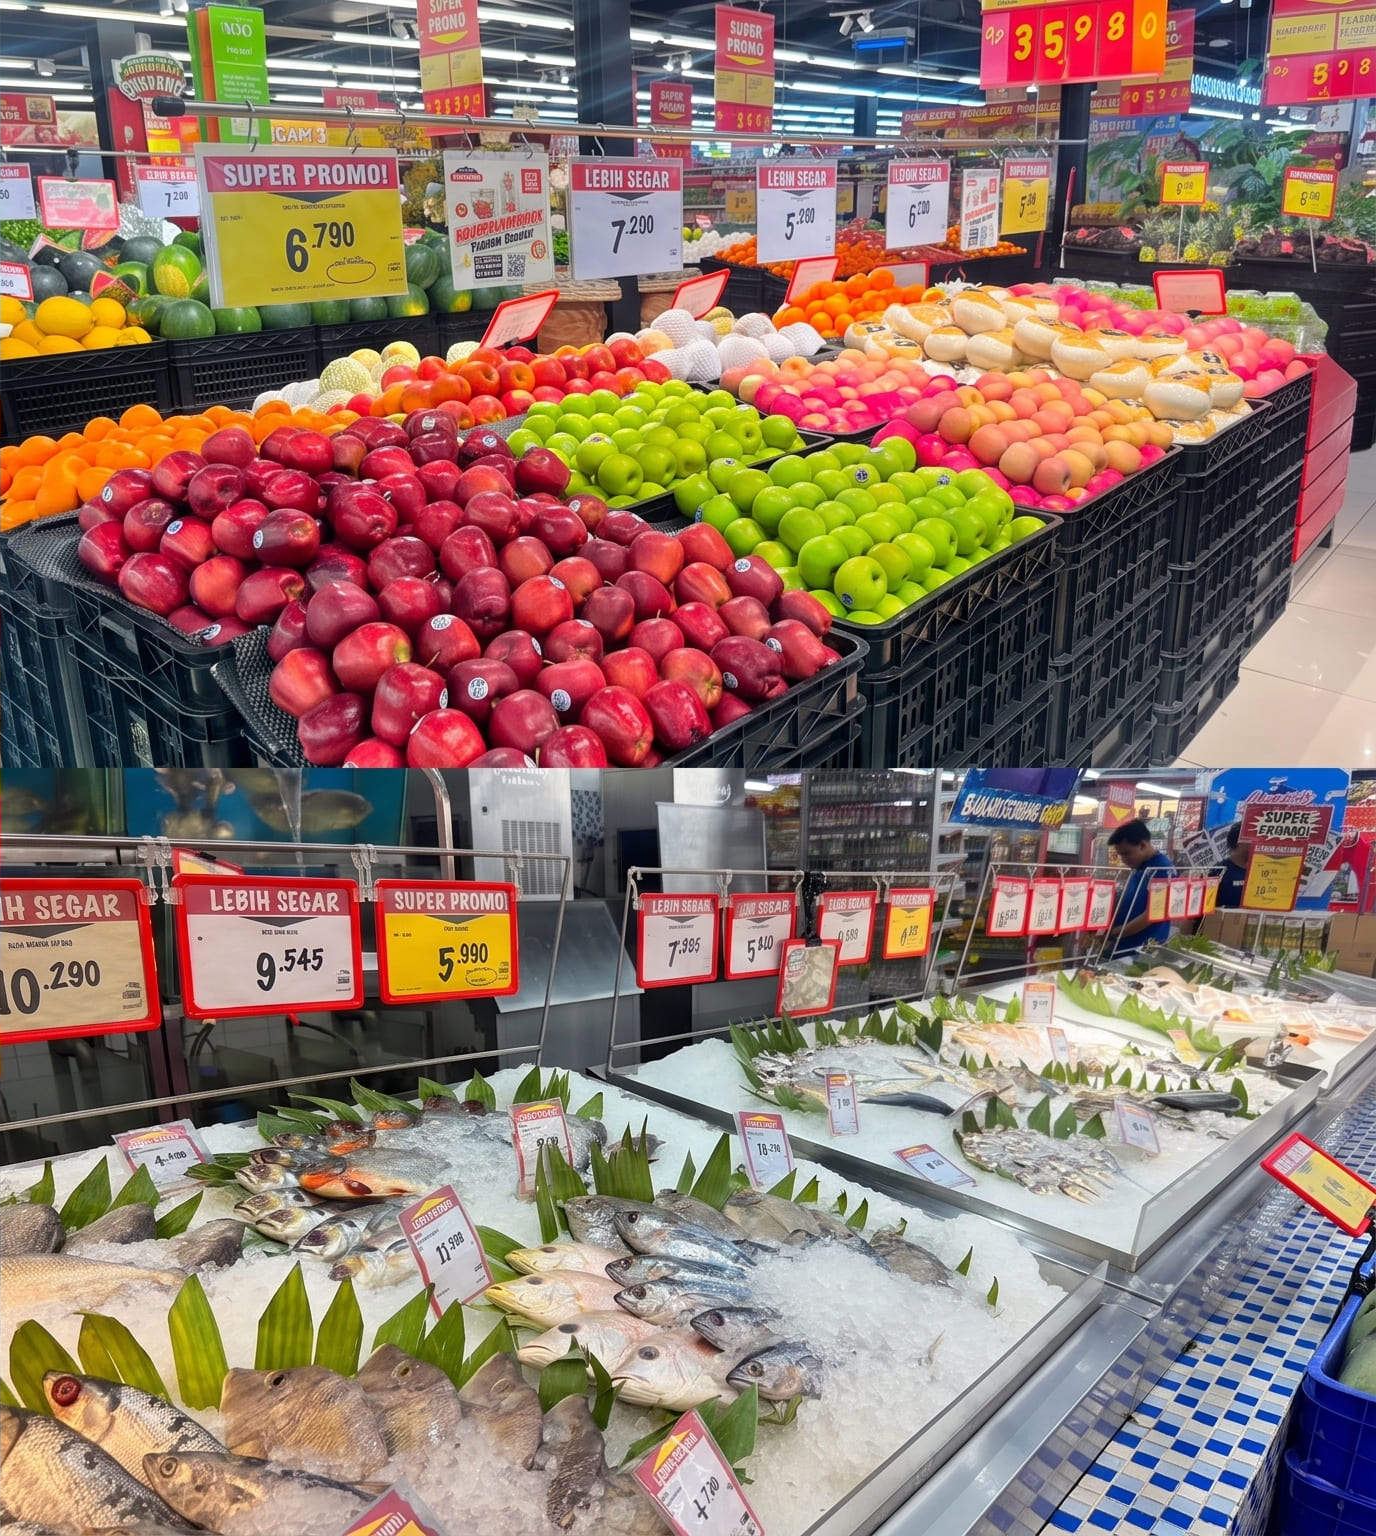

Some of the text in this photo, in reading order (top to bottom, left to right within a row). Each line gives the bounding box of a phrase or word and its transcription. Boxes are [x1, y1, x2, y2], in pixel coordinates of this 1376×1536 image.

[223, 163, 297, 187] SUPER
[303, 163, 389, 186] PROMO!
[585, 168, 670, 189] LEBIH SEGAR
[285, 221, 355, 273] 6.790
[611, 214, 654, 254] 7.200
[35, 893, 121, 921] SEGAR
[210, 888, 341, 913] LEBIH SEGAR
[394, 891, 446, 910] SUPER
[256, 947, 324, 992] 9.545
[438, 942, 489, 983] 5.990
